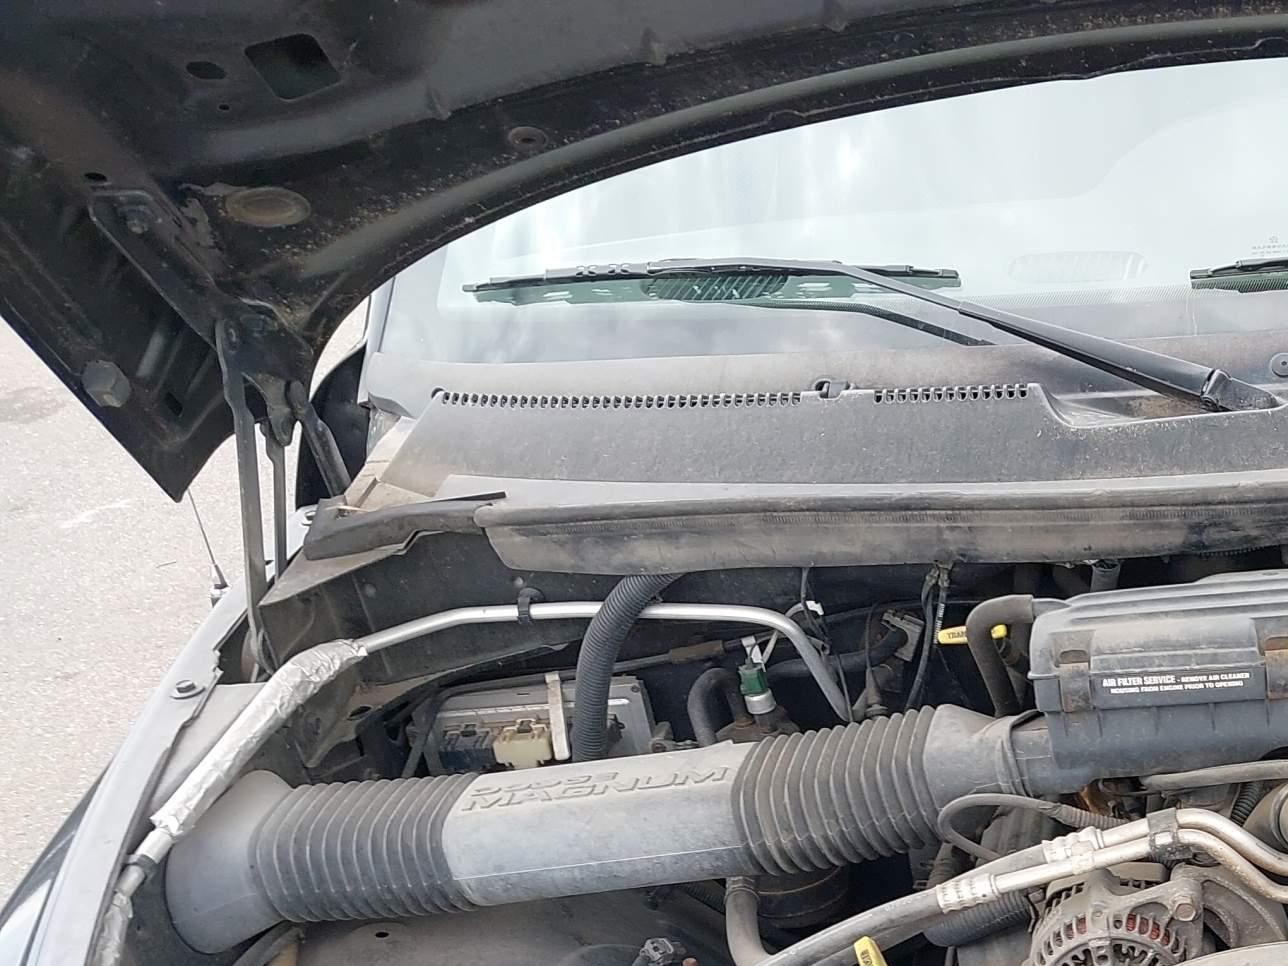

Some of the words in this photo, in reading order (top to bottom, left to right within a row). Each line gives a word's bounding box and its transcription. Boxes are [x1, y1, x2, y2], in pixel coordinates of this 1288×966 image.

[1102, 678, 1117, 687] AIR
[1117, 676, 1143, 686] FILTER
[1143, 674, 1176, 685] SERVICE
[1181, 675, 1208, 683] REMOVE
[1208, 673, 1220, 681] AIR
[1220, 672, 1250, 680] CLEANER
[1184, 682, 1204, 690] PRIOR
[461, 766, 732, 812] MAGNUM
